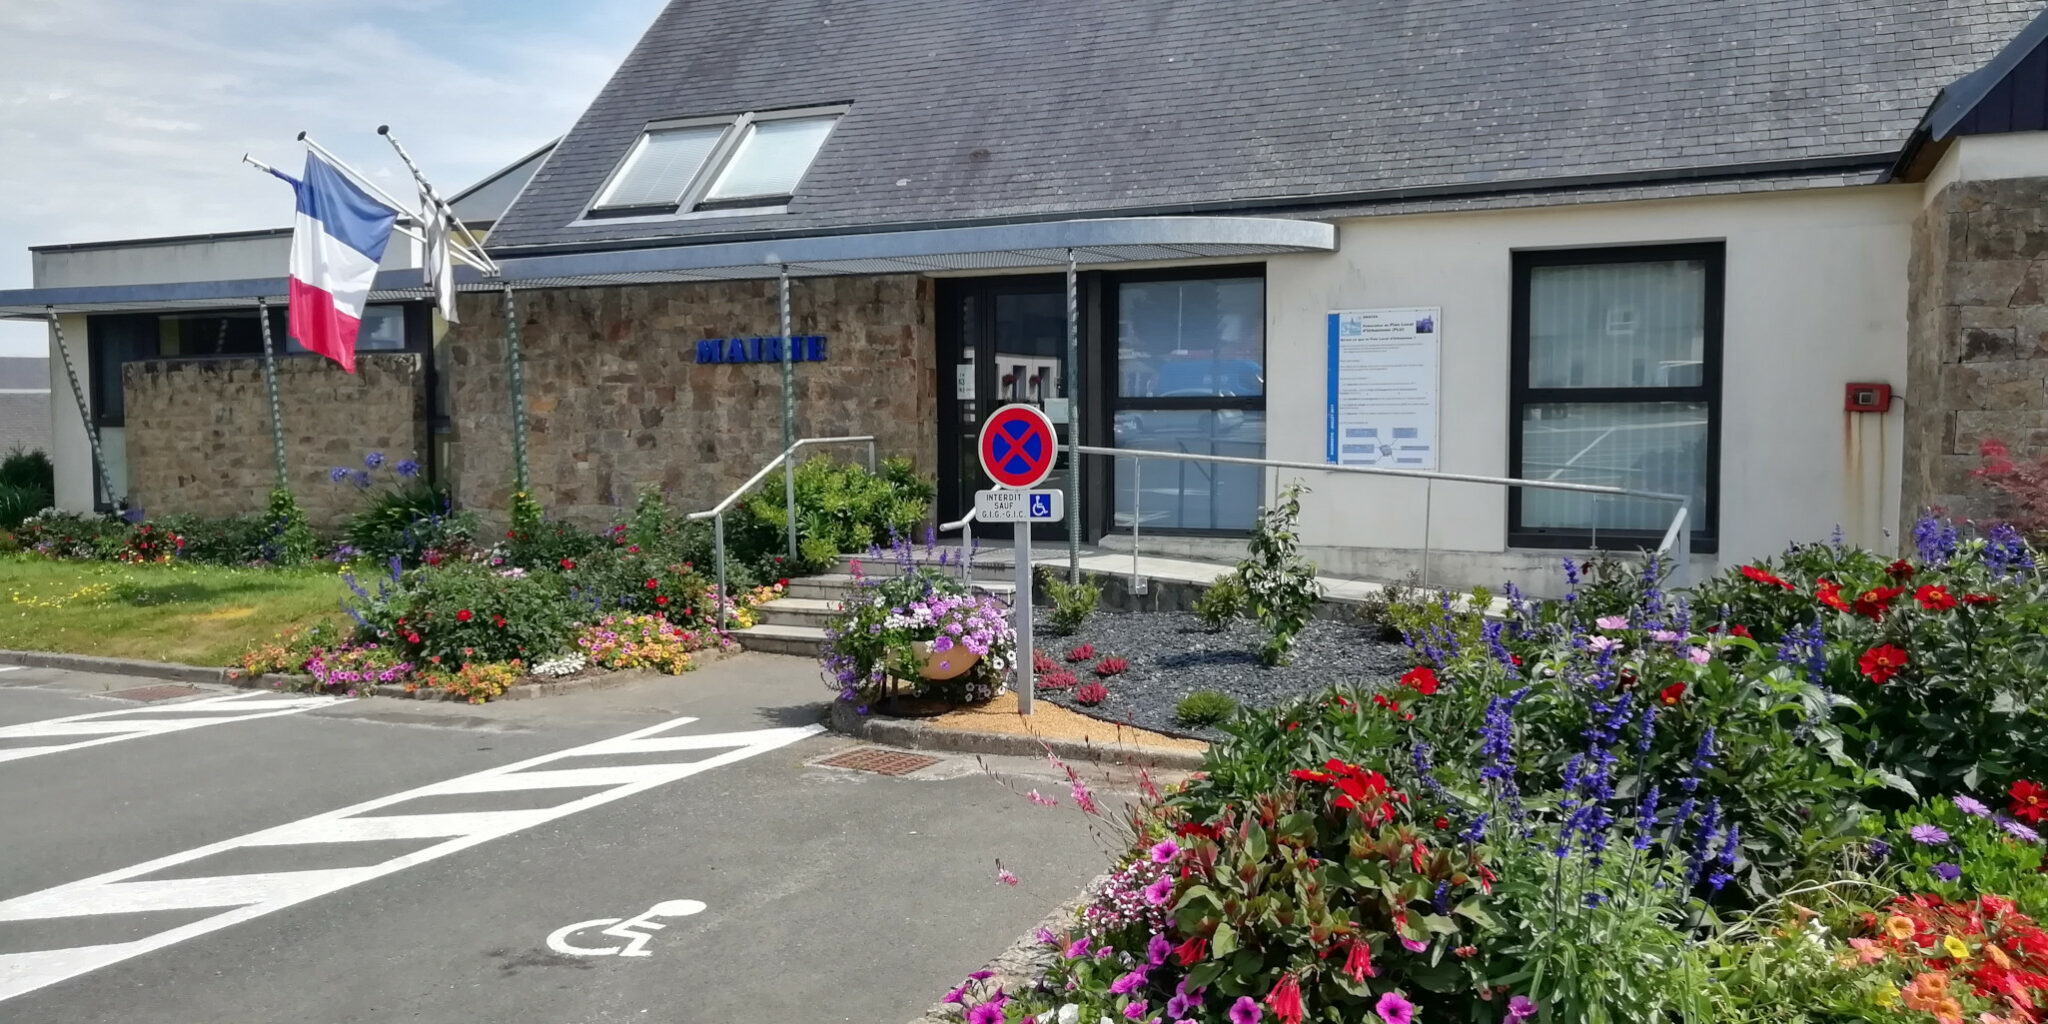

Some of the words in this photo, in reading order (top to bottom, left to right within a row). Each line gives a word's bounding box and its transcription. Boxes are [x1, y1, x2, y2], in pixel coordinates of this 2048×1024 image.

[696, 336, 826, 364] MAIRIE
[986, 493, 1021, 502] INTERDIT
[994, 502, 1014, 510] SAUF
